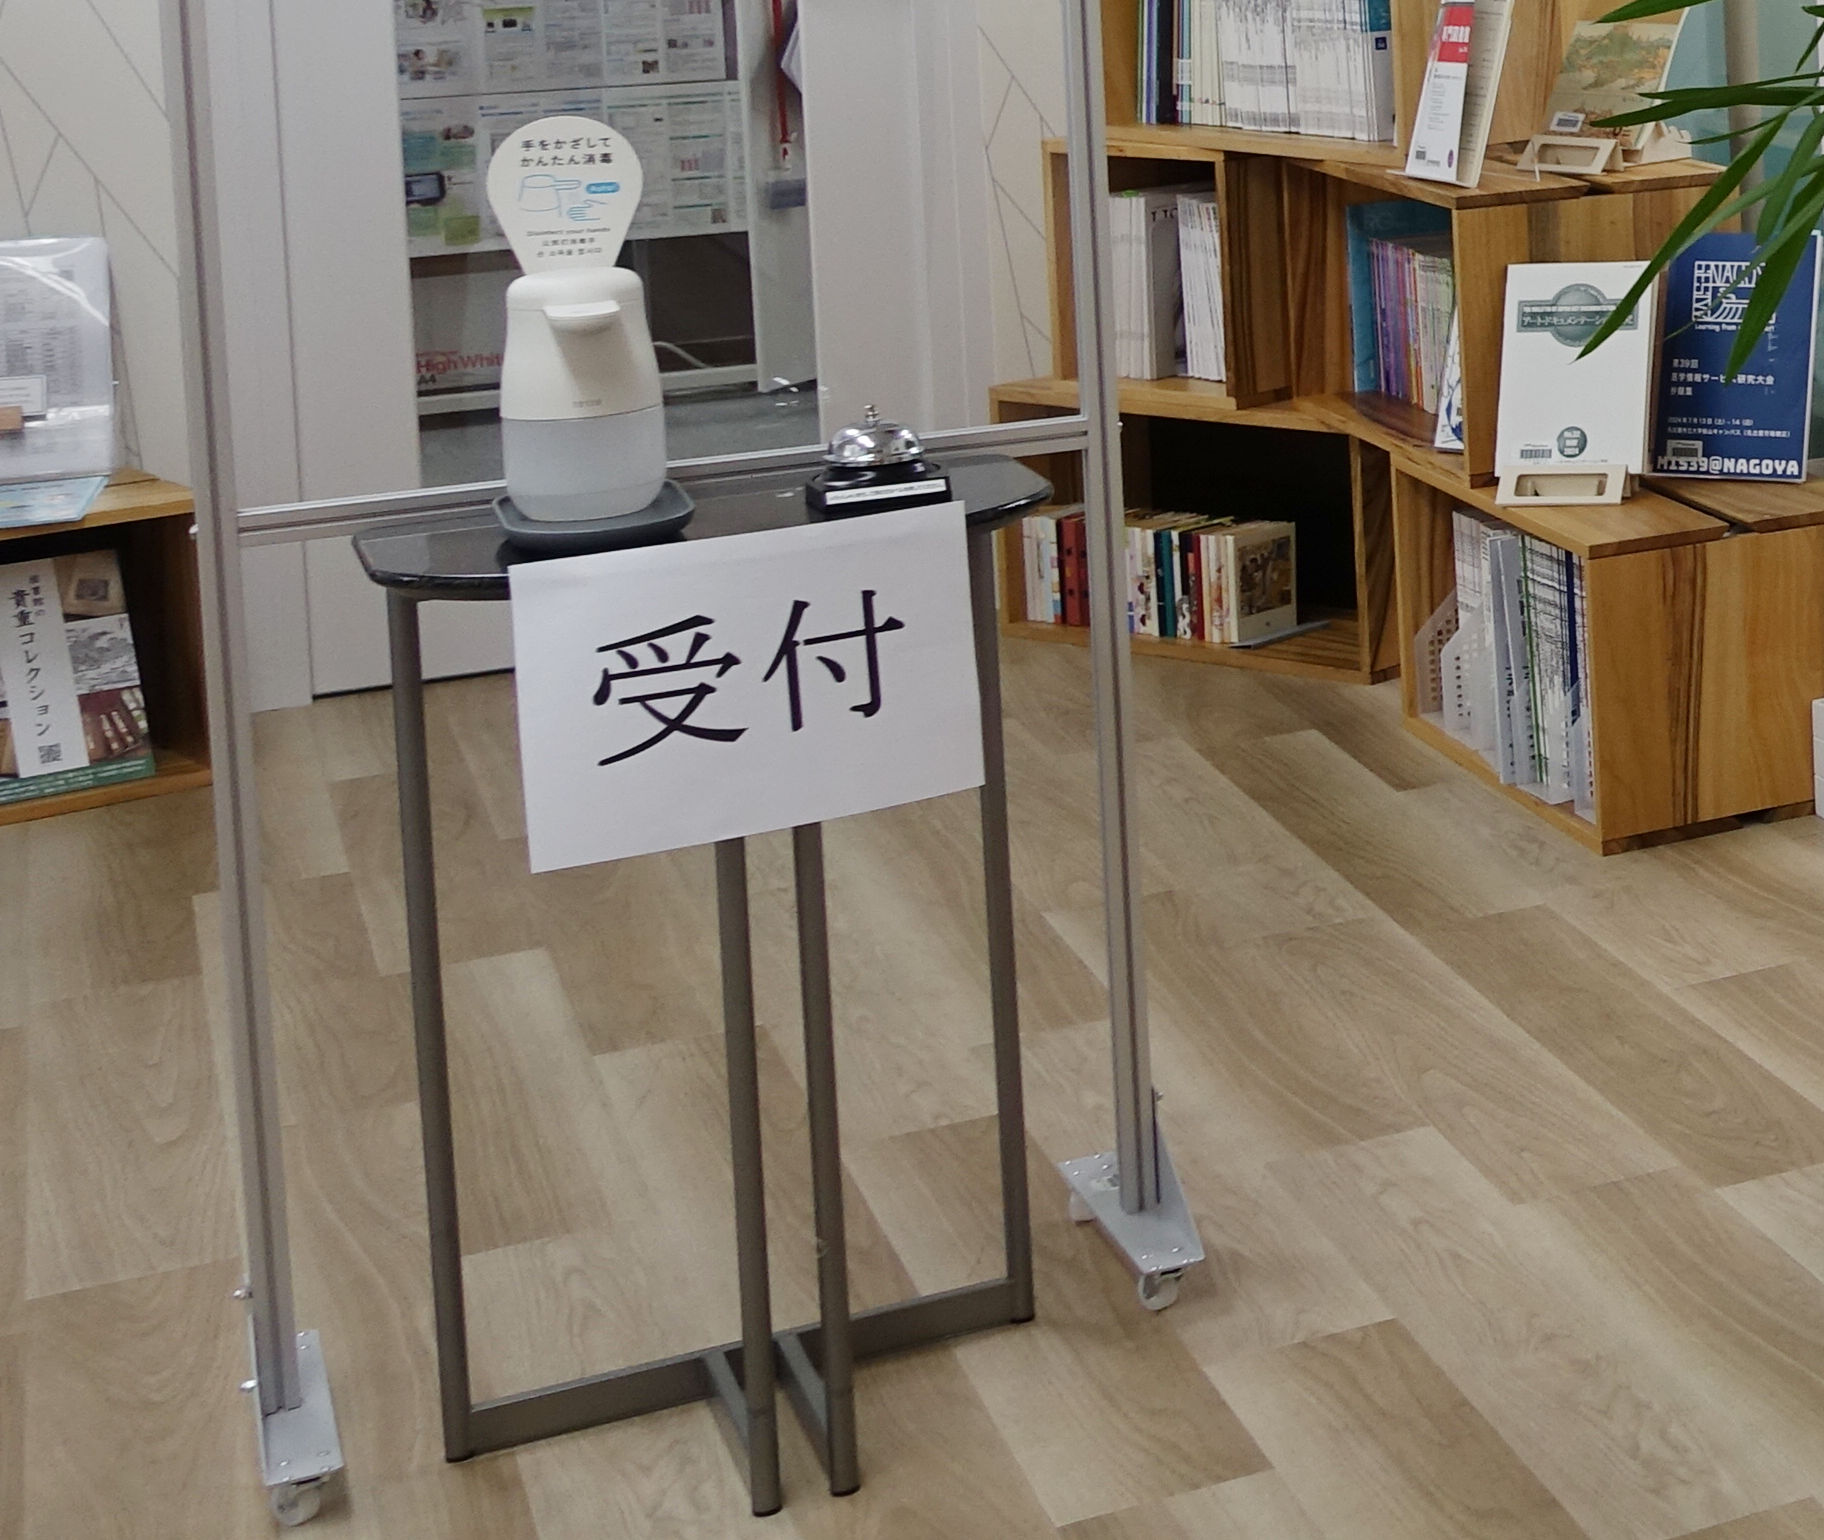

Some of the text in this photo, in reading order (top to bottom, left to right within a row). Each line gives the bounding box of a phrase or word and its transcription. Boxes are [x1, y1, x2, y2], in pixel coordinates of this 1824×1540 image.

[520, 137, 613, 152] 手をかざして
[520, 152, 614, 168] かんたん消毒
[416, 352, 457, 378] High
[8, 588, 52, 737] 貴重コレクション
[592, 589, 904, 767] 受付
